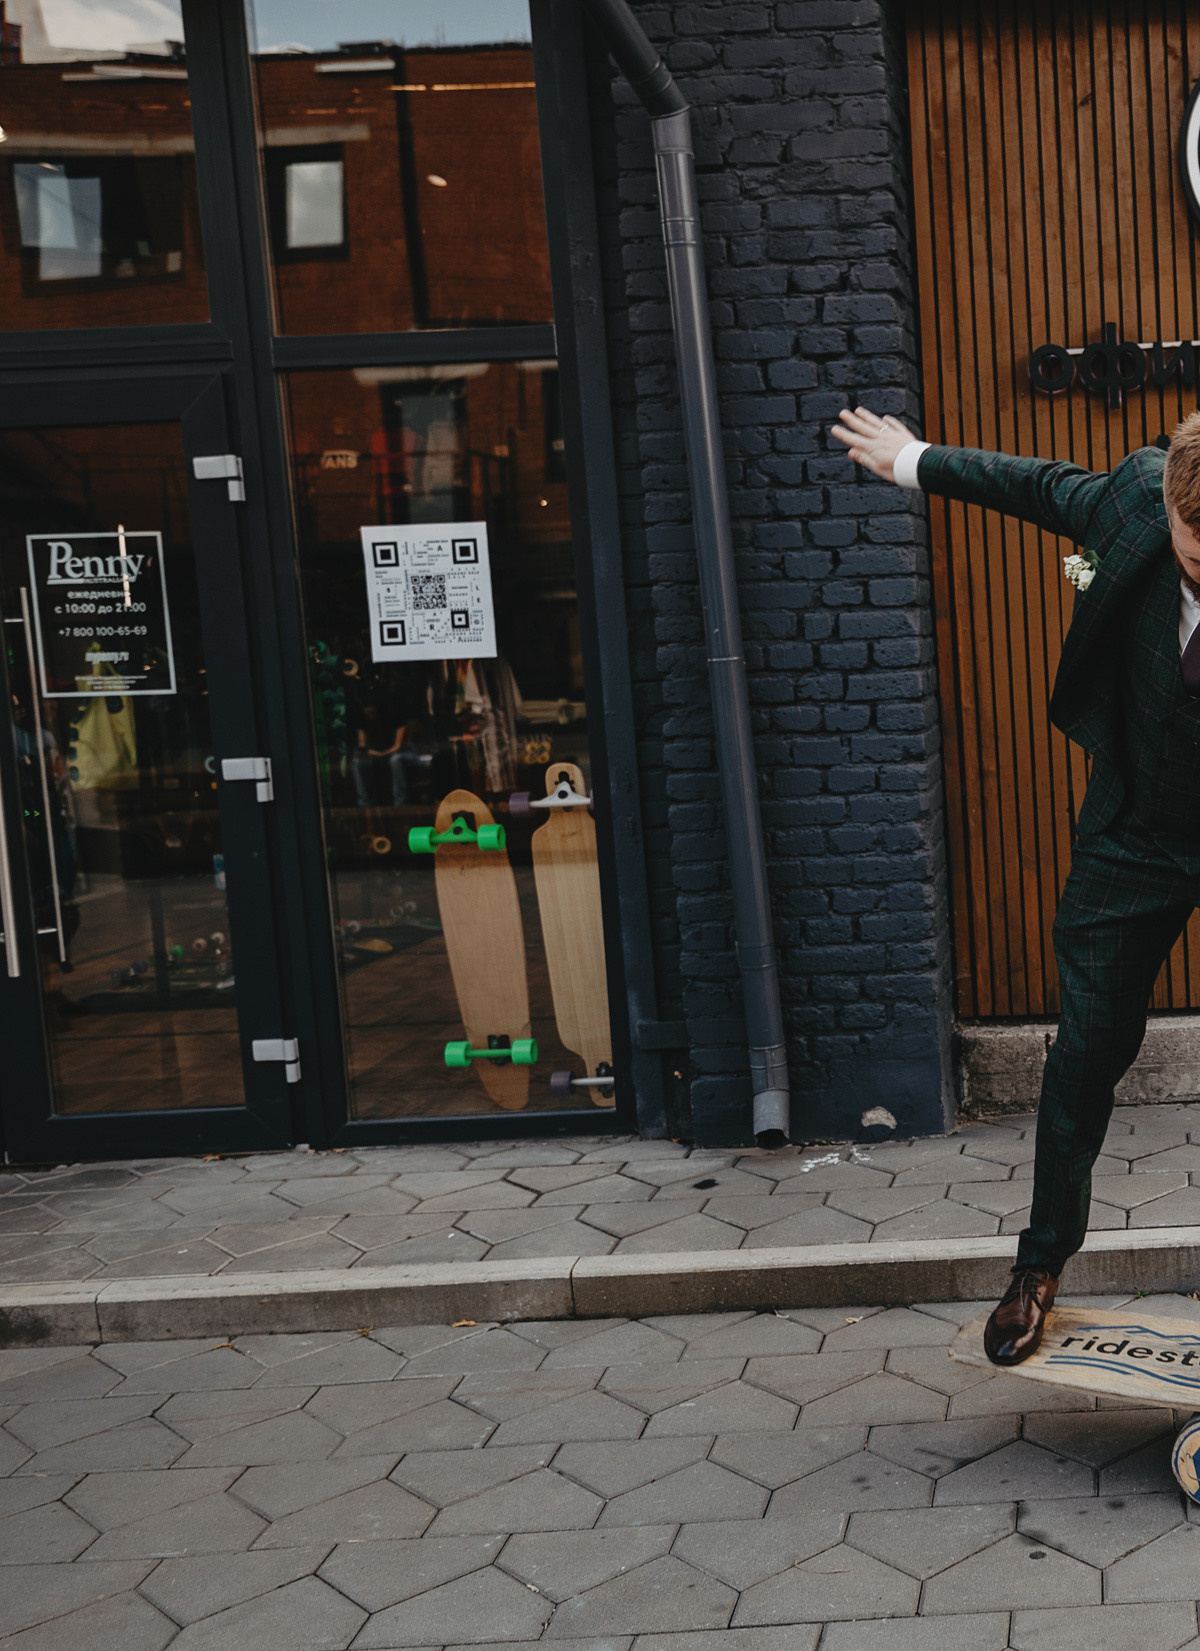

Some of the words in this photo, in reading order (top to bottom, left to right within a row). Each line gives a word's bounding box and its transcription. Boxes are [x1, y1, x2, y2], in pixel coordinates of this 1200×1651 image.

[65, 603, 96, 614] 10:00
[98, 605, 113, 615] до
[59, 627, 71, 637] +7
